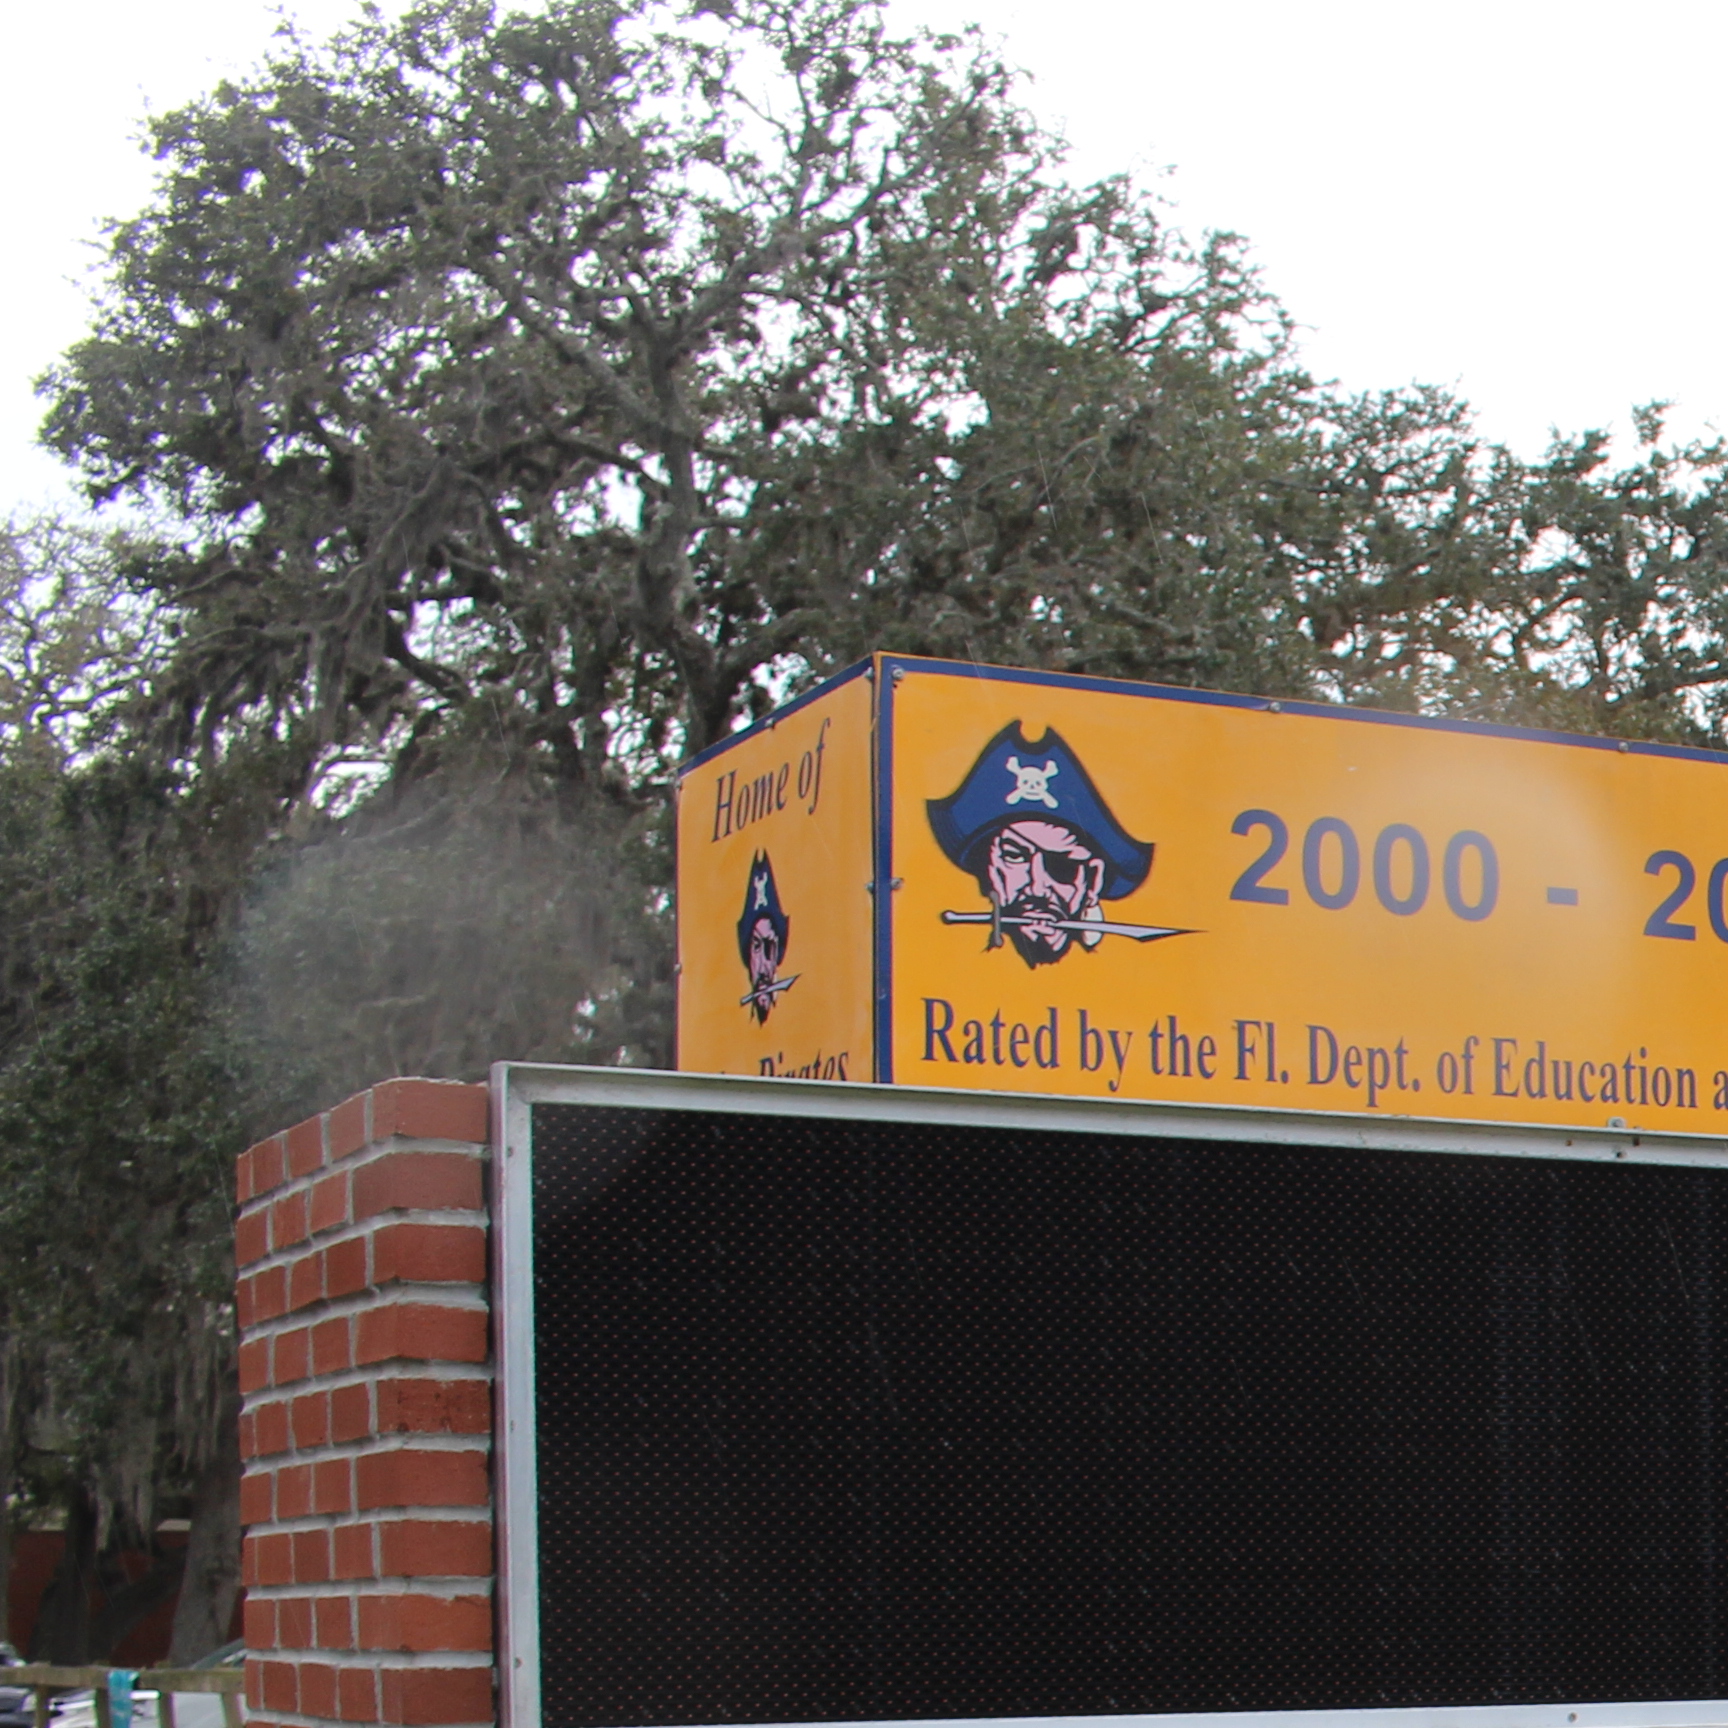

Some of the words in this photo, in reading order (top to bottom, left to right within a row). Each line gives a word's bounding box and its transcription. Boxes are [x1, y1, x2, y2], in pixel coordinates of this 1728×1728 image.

[711, 768, 789, 843] Home
[798, 716, 830, 815] of
[1229, 808, 1499, 922] 2000
[1546, 886, 1578, 906] -
[920, 997, 1060, 1069] Rated
[1077, 1008, 1133, 1093] by
[1148, 1015, 1217, 1080] the
[1233, 1019, 1290, 1085] Fl.
[1306, 1023, 1420, 1108] Dept.
[1436, 1035, 1480, 1096] of
[1490, 1036, 1699, 1109] Education
